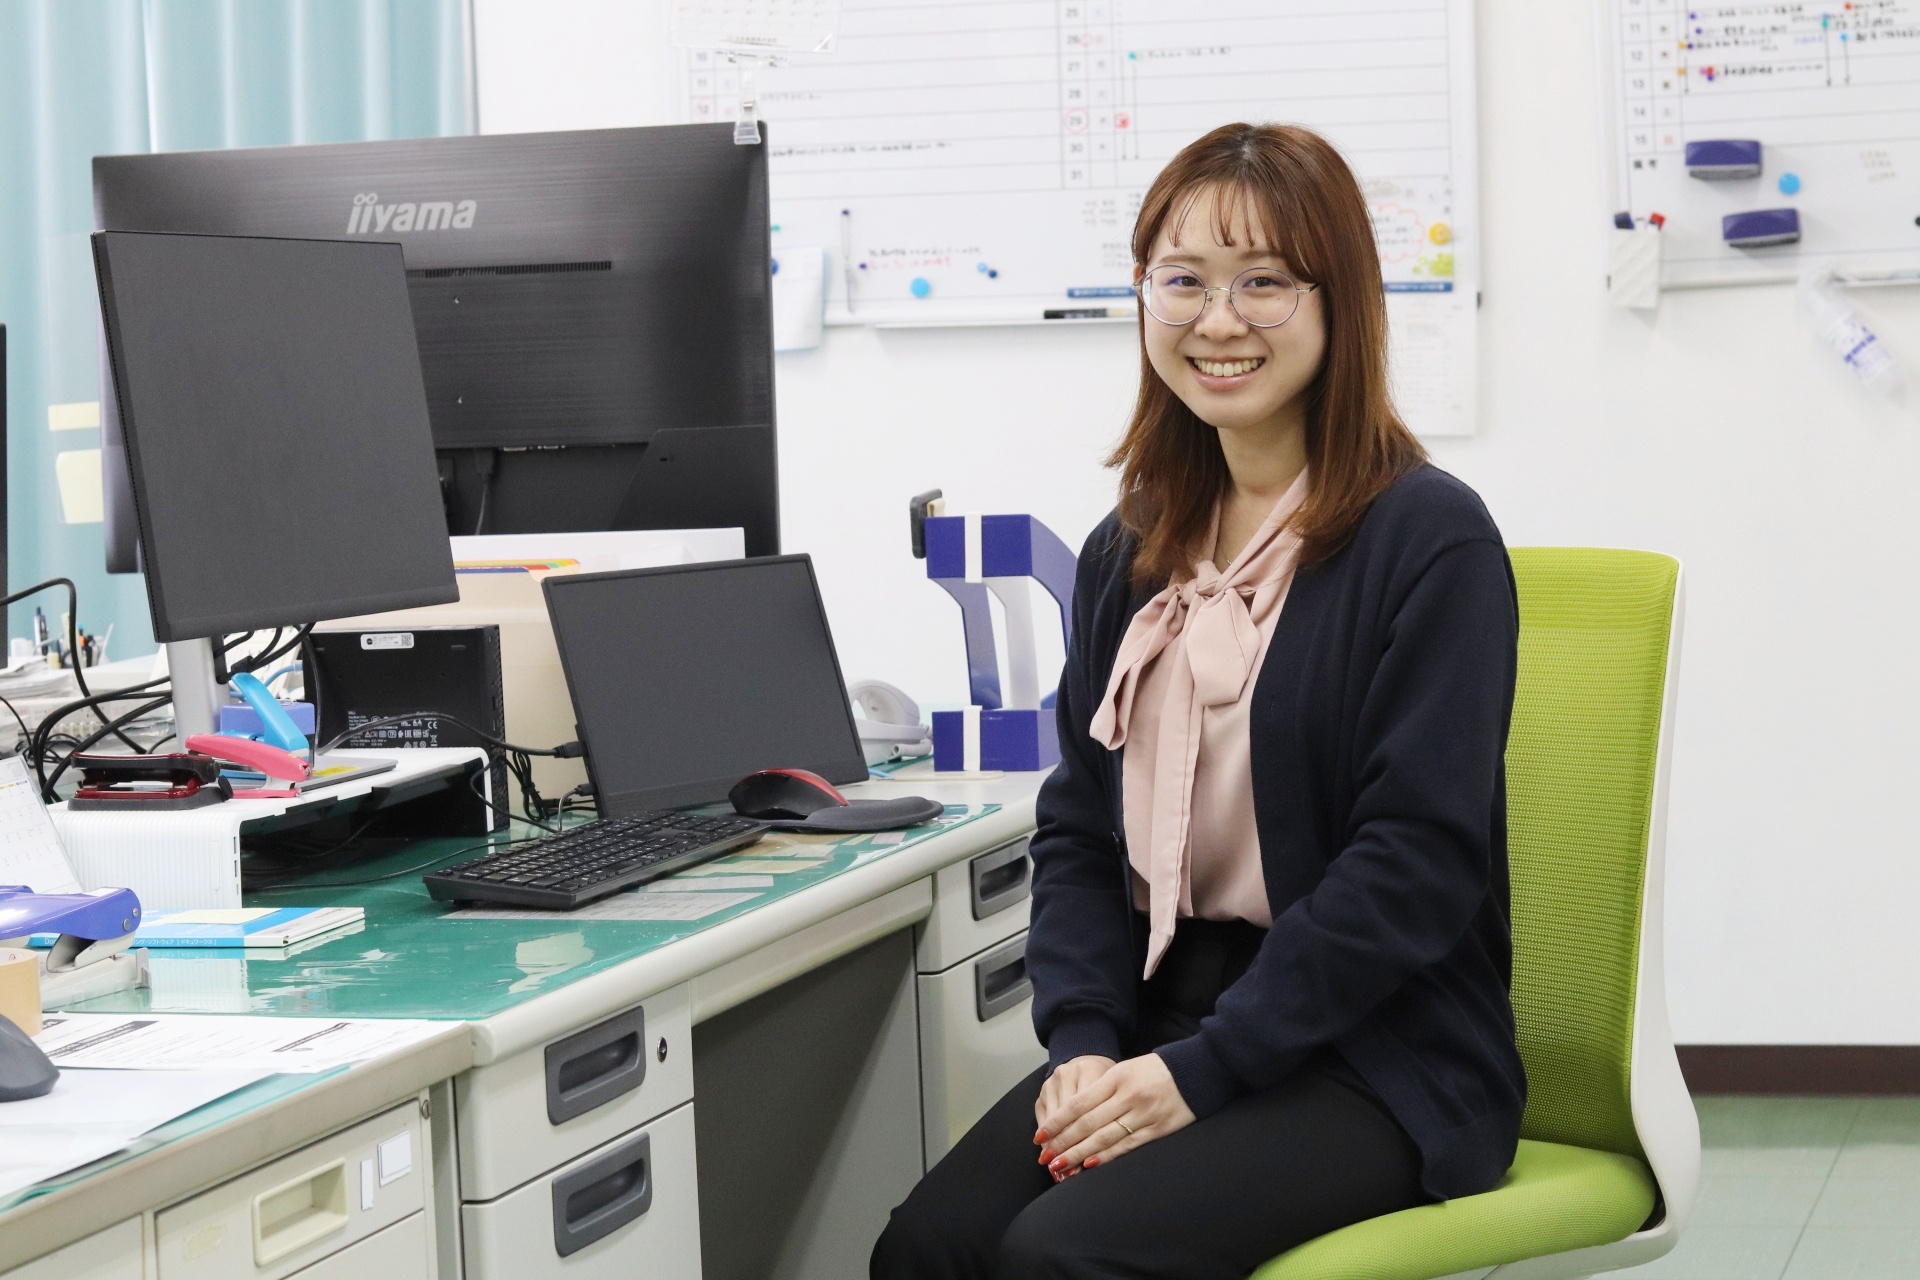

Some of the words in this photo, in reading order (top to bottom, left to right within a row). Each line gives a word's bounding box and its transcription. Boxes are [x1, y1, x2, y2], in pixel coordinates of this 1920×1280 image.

[1067, 61, 1080, 71] 27
[1071, 143, 1083, 153] 30
[1071, 170, 1083, 180] 31
[346, 193, 477, 234] iiyama
